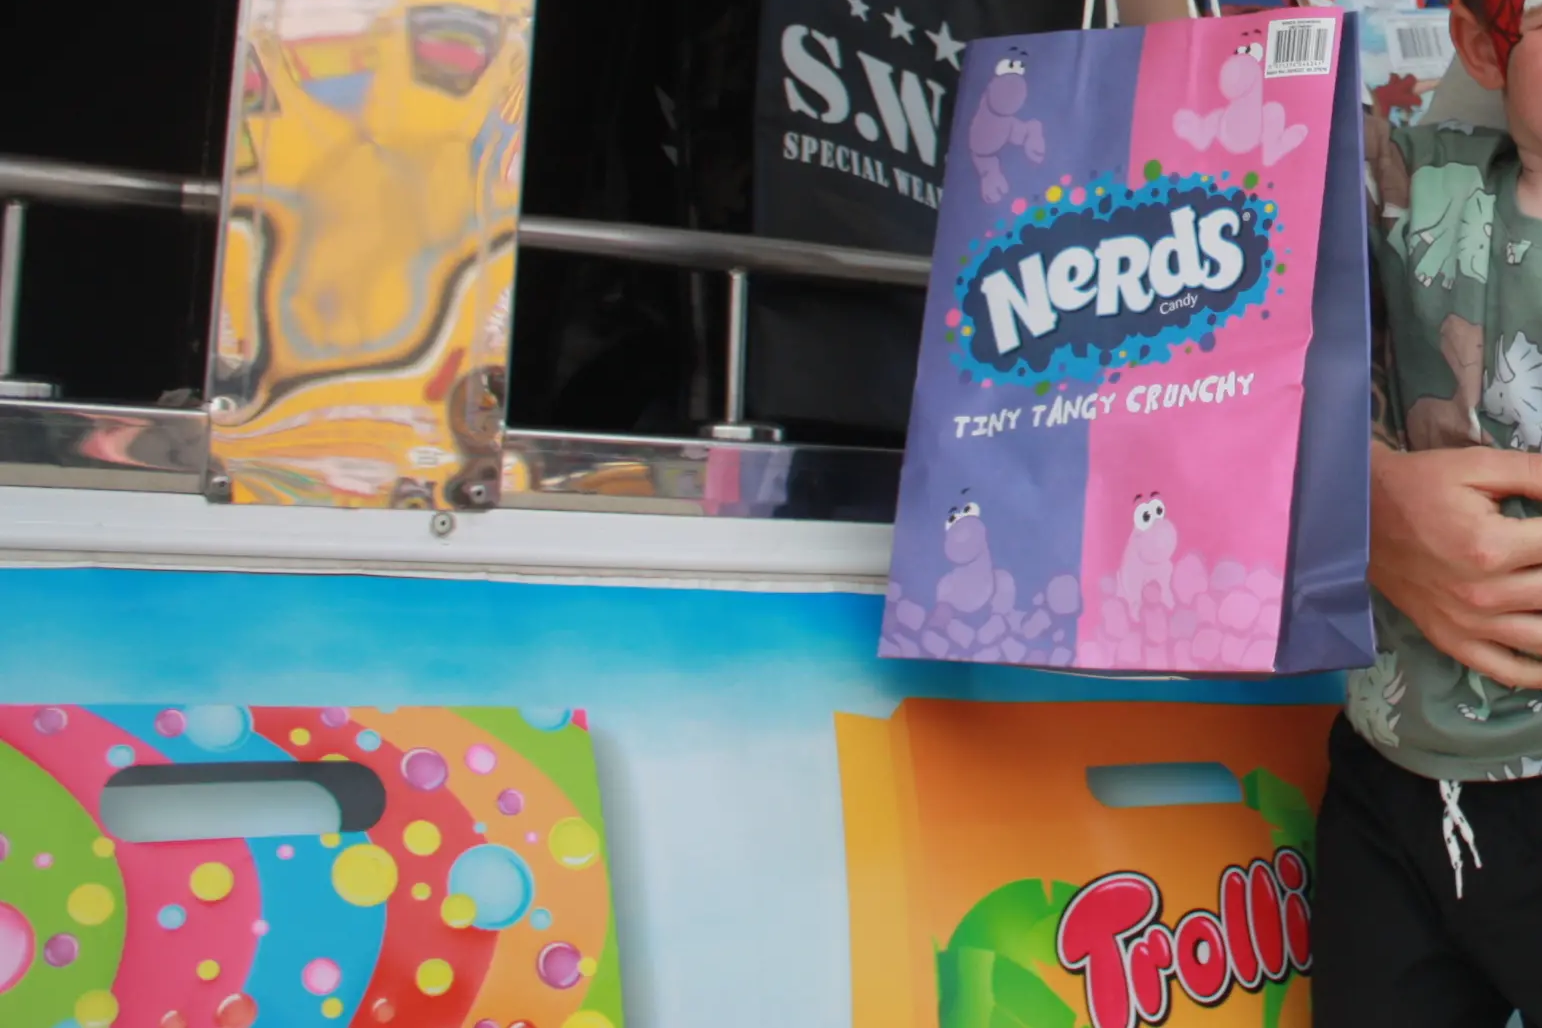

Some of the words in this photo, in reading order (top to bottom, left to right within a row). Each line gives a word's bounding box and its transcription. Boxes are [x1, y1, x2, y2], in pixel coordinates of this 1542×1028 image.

[783, 130, 889, 189] SPECIAL
[1159, 292, 1199, 317] Candy
[953, 408, 1021, 438] TINY
[1031, 392, 1117, 429] TANGY
[1126, 372, 1255, 415] CRUNCHY
[1057, 849, 1312, 1028] Trolli
